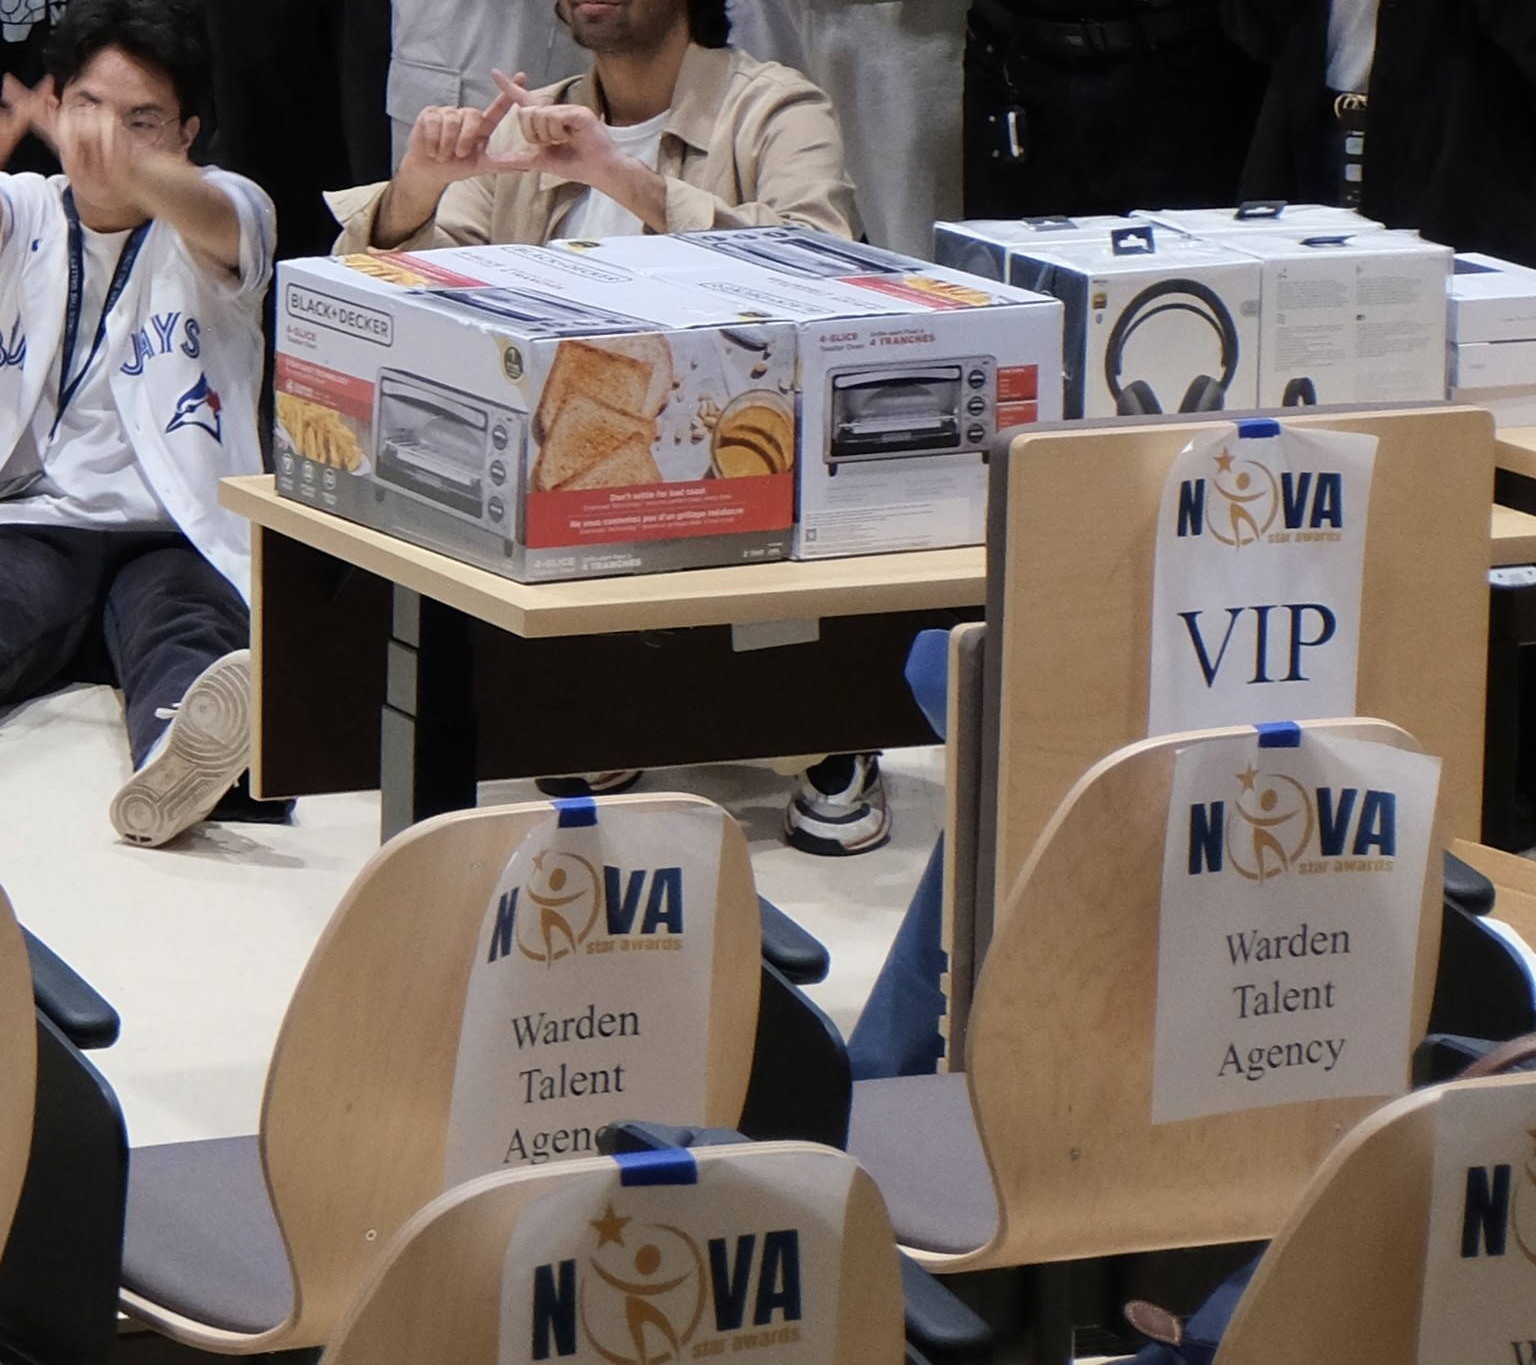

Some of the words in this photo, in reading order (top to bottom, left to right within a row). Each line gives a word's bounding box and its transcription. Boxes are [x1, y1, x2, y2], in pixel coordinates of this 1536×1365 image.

[291, 293, 390, 338] BLACK+DECKER
[120, 311, 201, 376] JAYS
[820, 332, 858, 343] 4-SLICE
[879, 333, 936, 346] TRANCHES
[1268, 531, 1292, 544] star
[1294, 530, 1342, 543] awards
[1177, 603, 1337, 688] VIP
[1298, 859, 1328, 875] star
[1334, 857, 1394, 873] awards
[586, 939, 615, 954] star
[620, 937, 683, 953] awards
[1226, 924, 1351, 966] Warden
[1233, 980, 1336, 1019] Talent
[512, 1004, 641, 1050] Warden
[1217, 1038, 1346, 1081] Agency
[519, 1063, 625, 1104] Talent
[503, 1126, 609, 1165] Agen
[692, 1338, 726, 1360] star
[732, 1326, 801, 1354] awards
